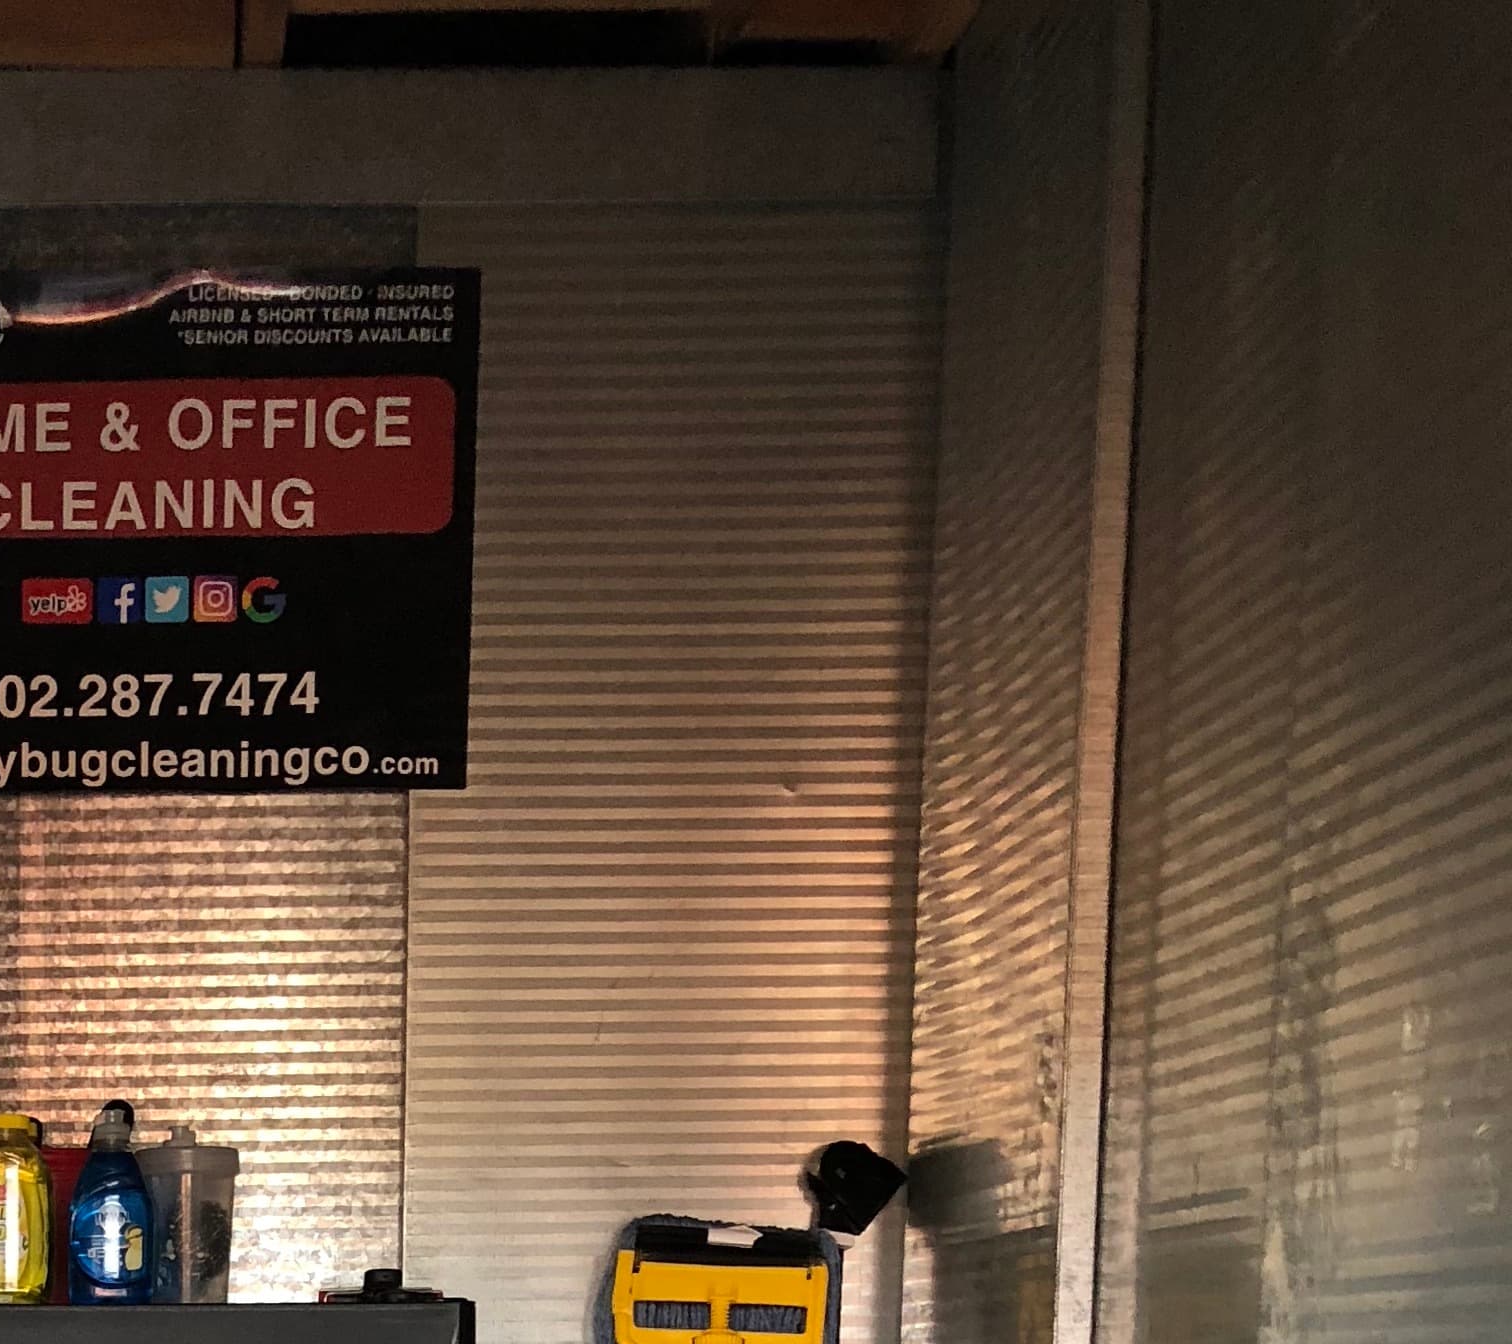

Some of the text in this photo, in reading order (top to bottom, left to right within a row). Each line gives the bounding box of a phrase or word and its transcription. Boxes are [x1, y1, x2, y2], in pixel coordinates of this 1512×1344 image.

[377, 285, 455, 300] INSURED
[169, 305, 455, 324] AIRBNB & SHORT TERM RENTALS
[254, 328, 354, 345] DISCOUNTS
[358, 326, 453, 343] AVAILABLE
[99, 402, 141, 453] &
[167, 396, 412, 450] OFFICE
[29, 595, 69, 617] yelp
